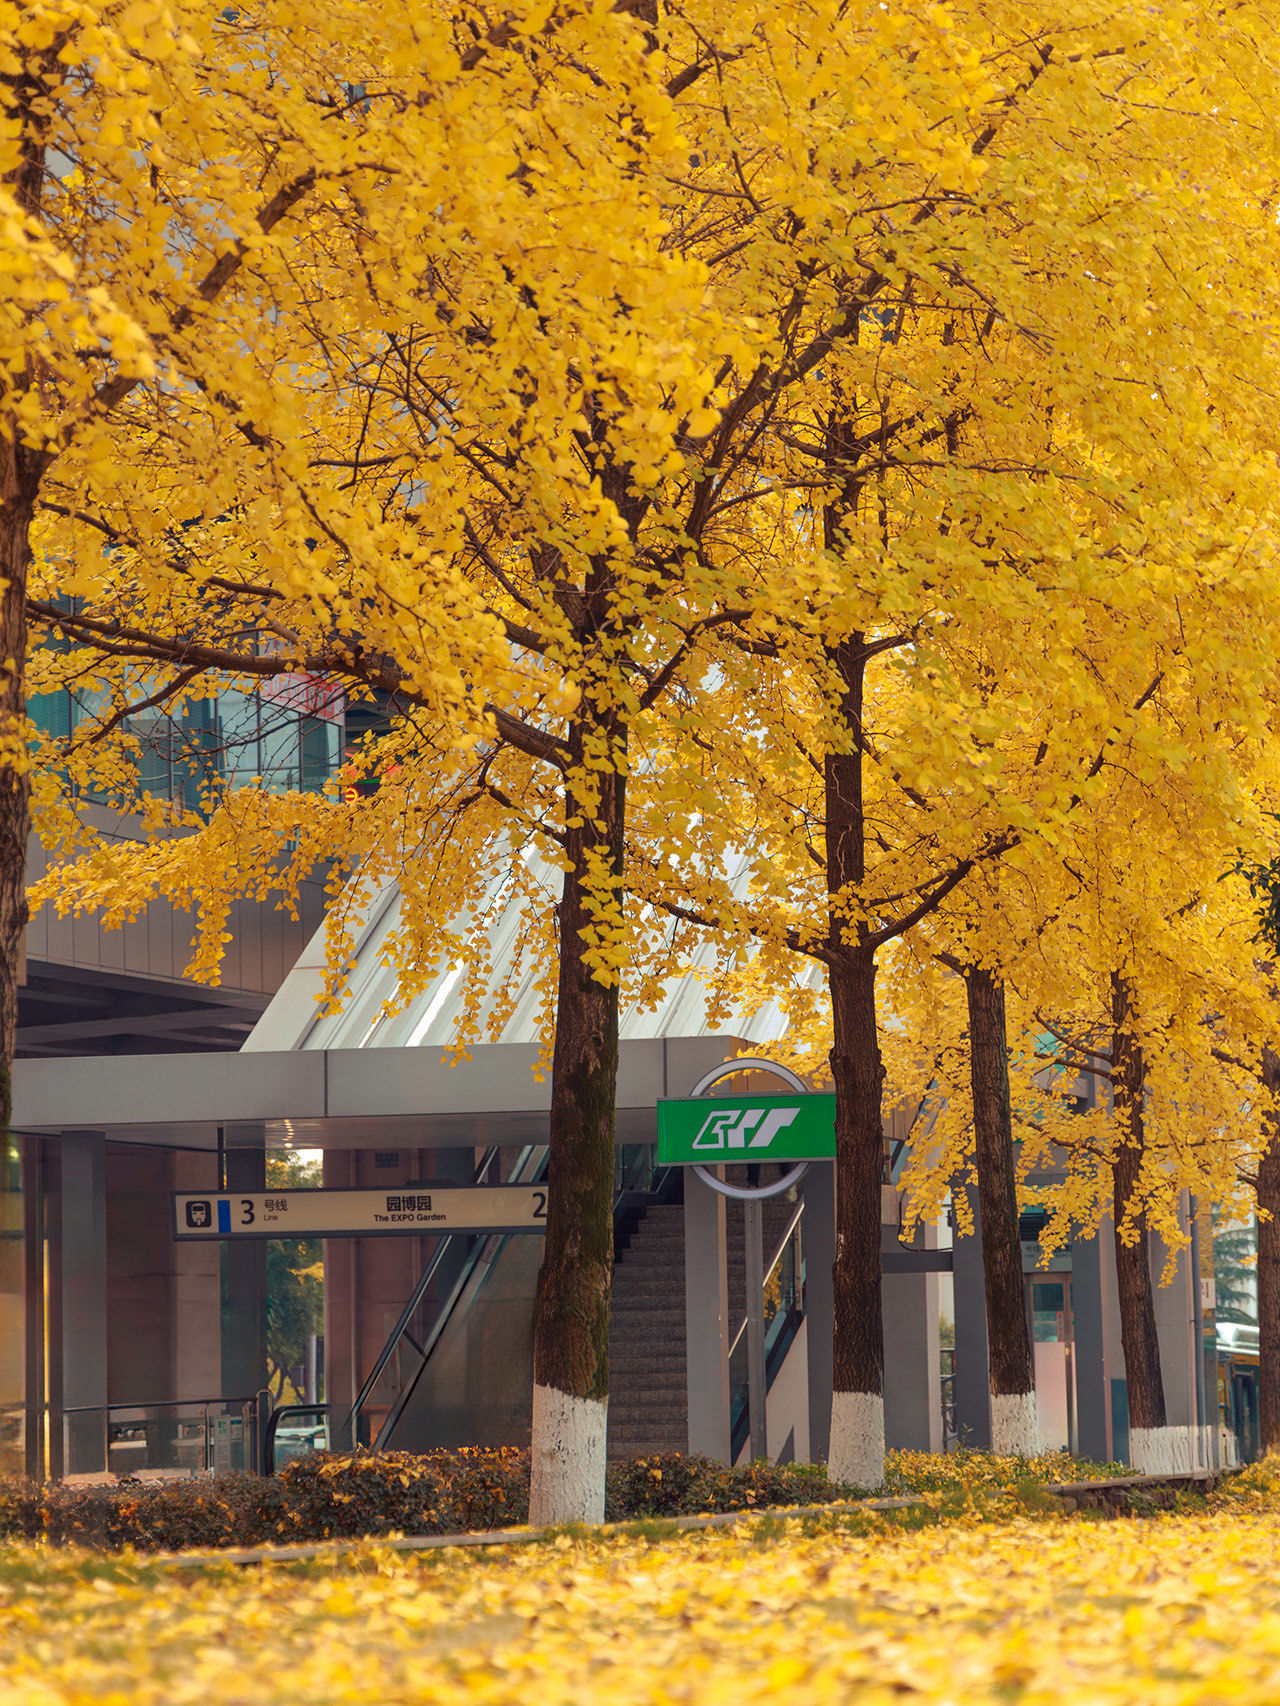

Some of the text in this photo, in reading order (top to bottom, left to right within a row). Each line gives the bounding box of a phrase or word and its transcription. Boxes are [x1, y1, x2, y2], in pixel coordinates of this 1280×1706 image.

[241, 1199, 288, 1225] 3 号线
[387, 1195, 432, 1213] 园博园
[533, 1192, 547, 1217] 2
[264, 1213, 279, 1221] Line
[374, 1213, 447, 1222] The EXPO Garden
